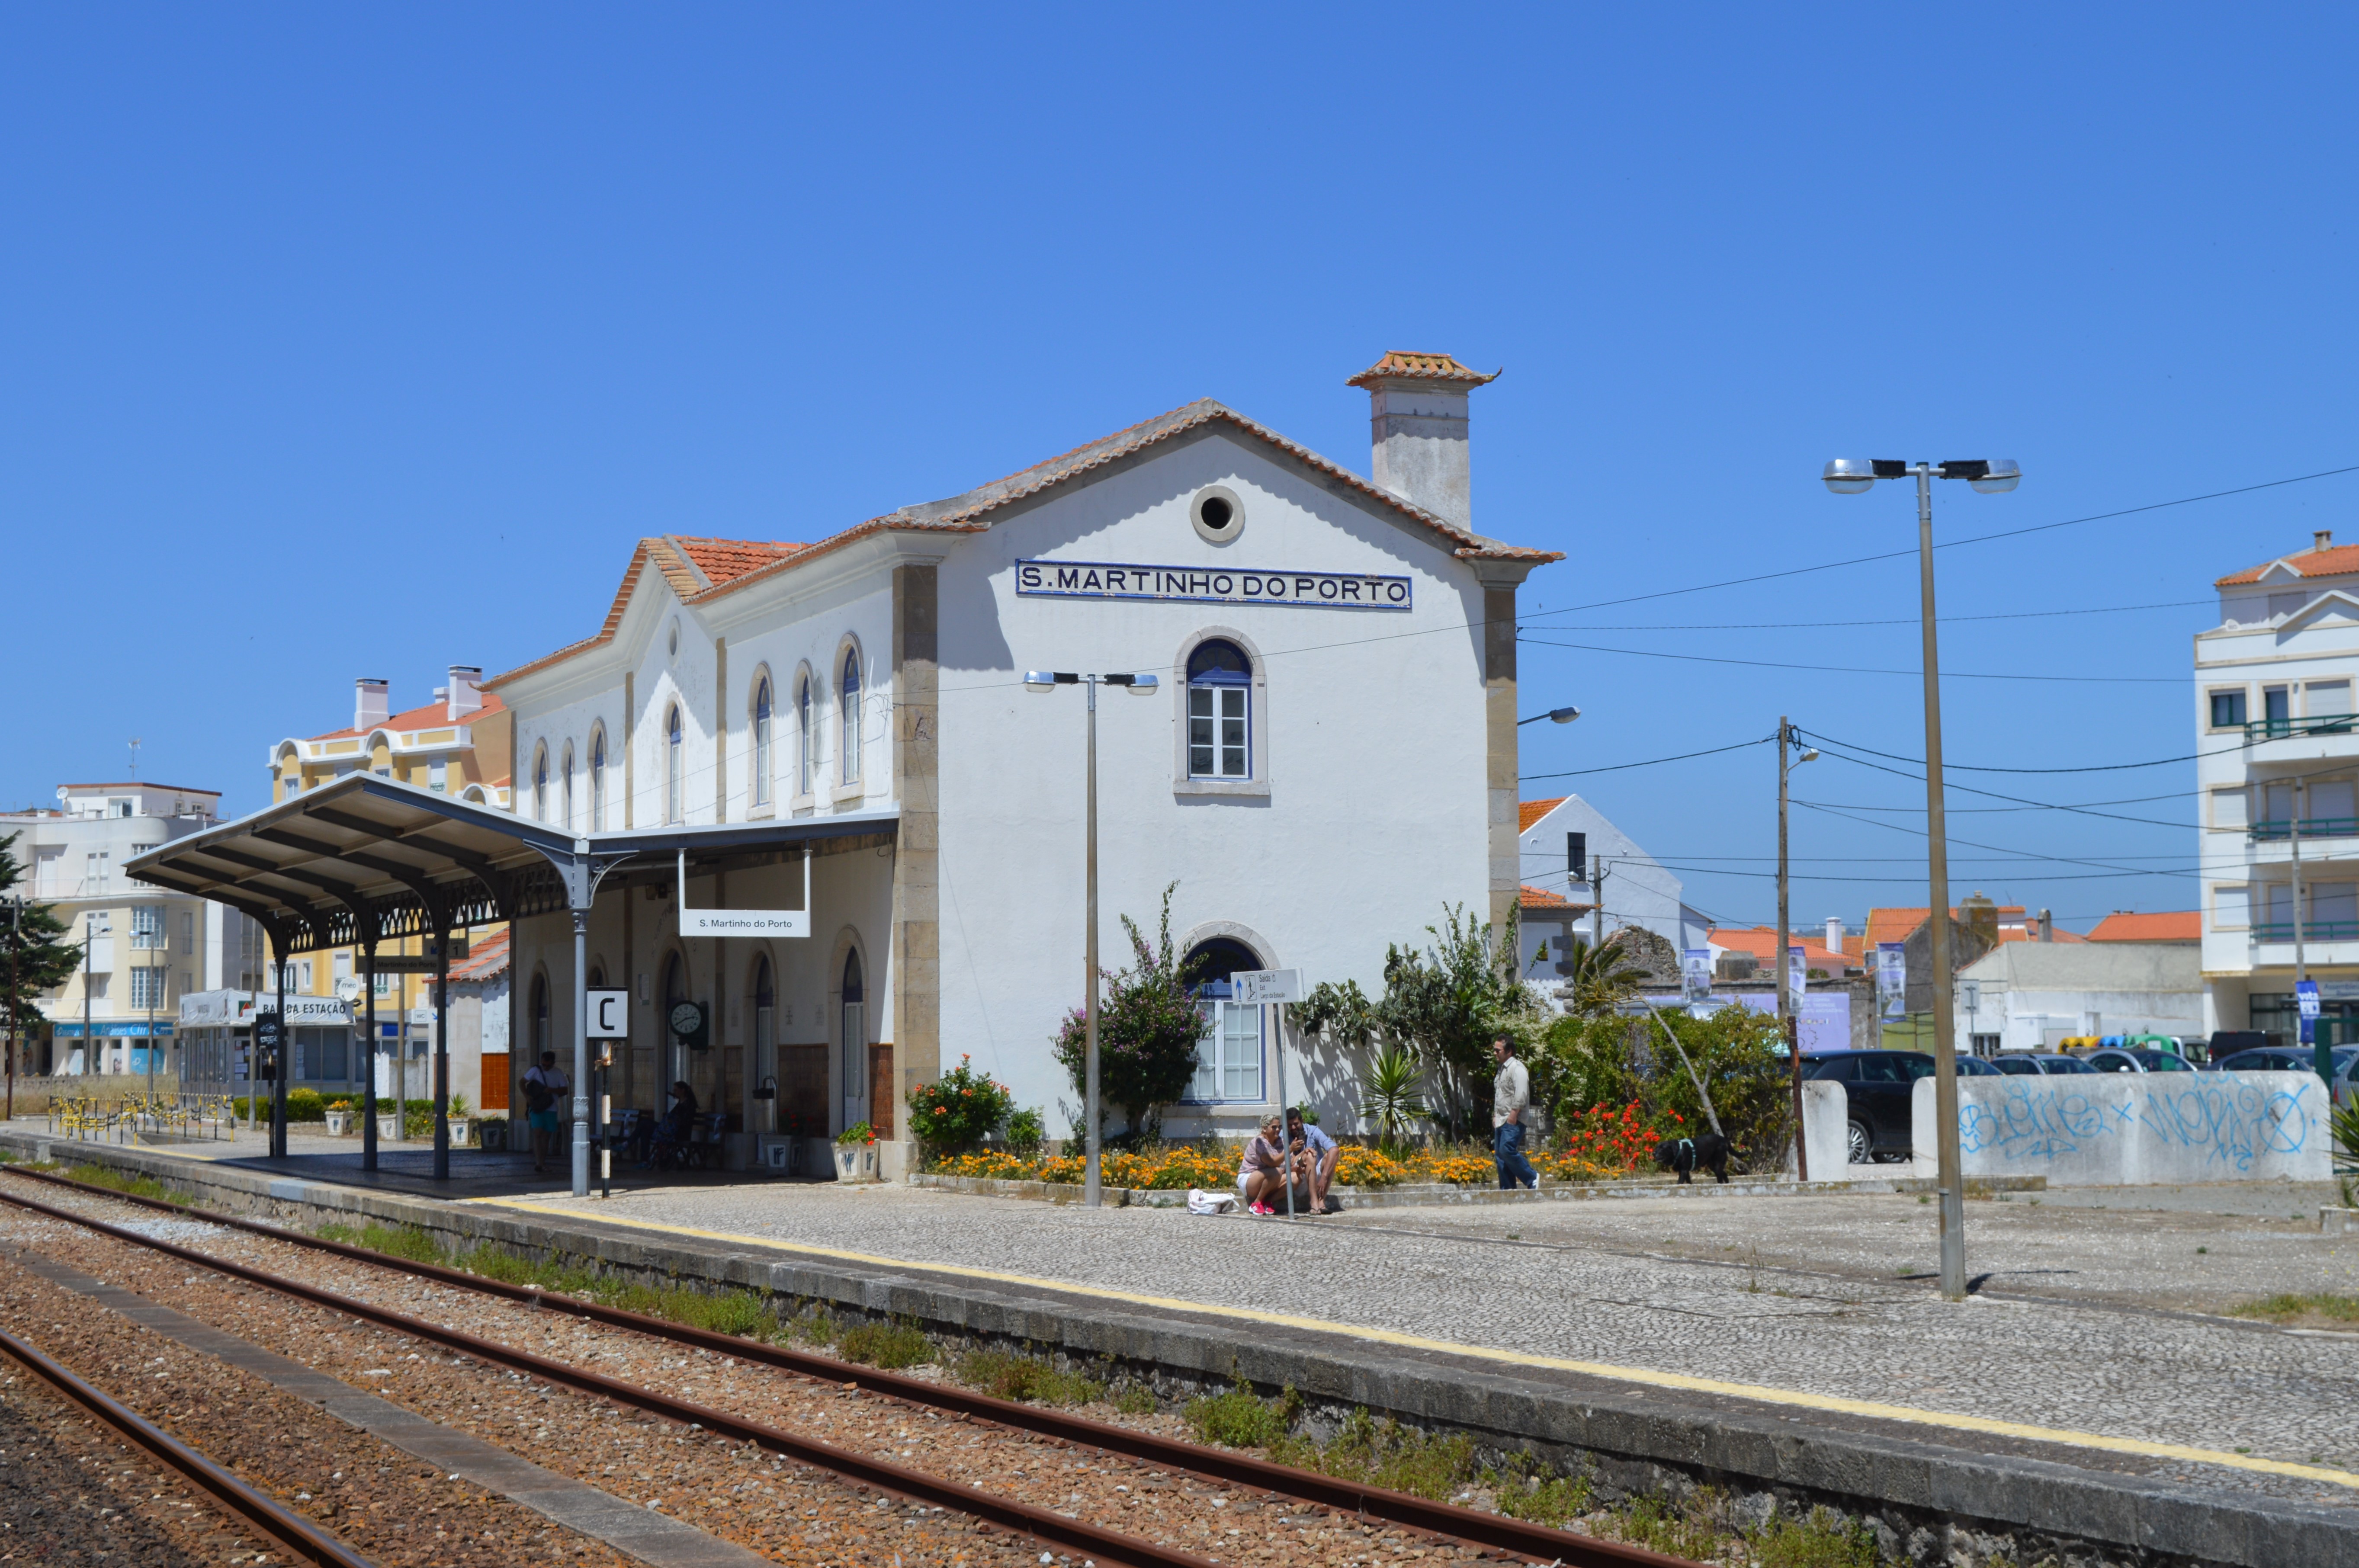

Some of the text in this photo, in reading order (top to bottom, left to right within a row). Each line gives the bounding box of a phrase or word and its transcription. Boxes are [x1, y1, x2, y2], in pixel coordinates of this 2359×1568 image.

[1243, 576, 1286, 596] DO
[1296, 578, 1406, 602] PORTO
[711, 920, 751, 928] Martinho
[453, 946, 458, 956] 1
[1259, 974, 1271, 982] Saída
[286, 1004, 299, 1013] DA
[303, 1002, 346, 1016] ESTAÇÃO
[600, 997, 615, 1030] C
